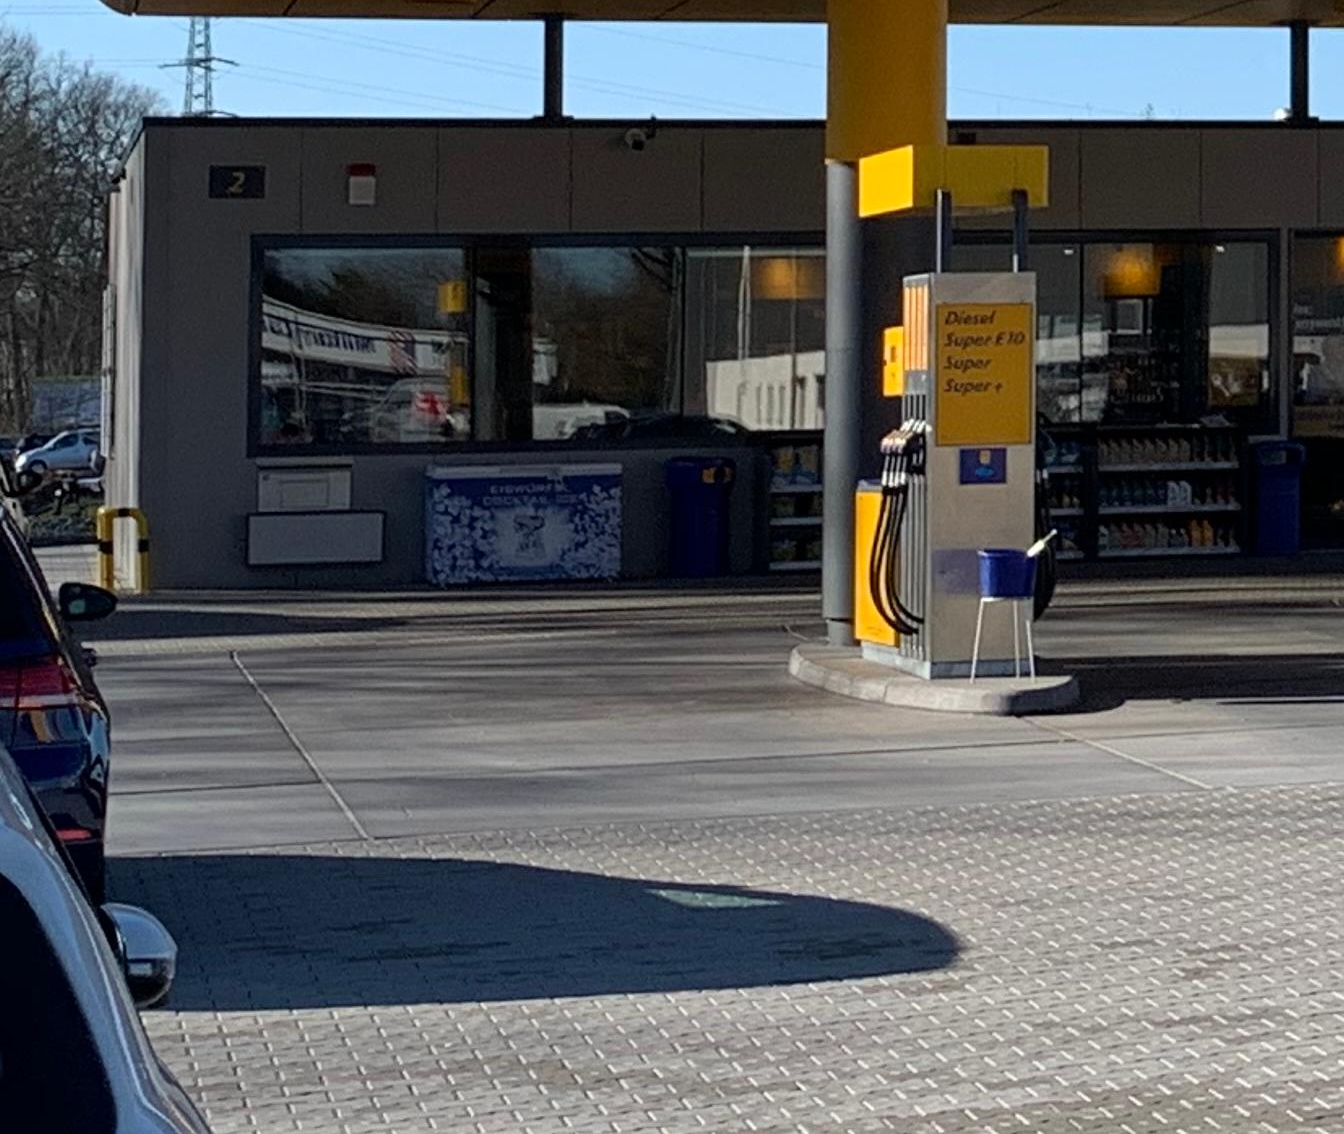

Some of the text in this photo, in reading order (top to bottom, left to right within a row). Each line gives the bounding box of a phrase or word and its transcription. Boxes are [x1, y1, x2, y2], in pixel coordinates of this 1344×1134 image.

[228, 171, 246, 194] 2
[944, 309, 997, 326] Diesel
[943, 331, 992, 351] Super
[943, 355, 993, 374] Super
